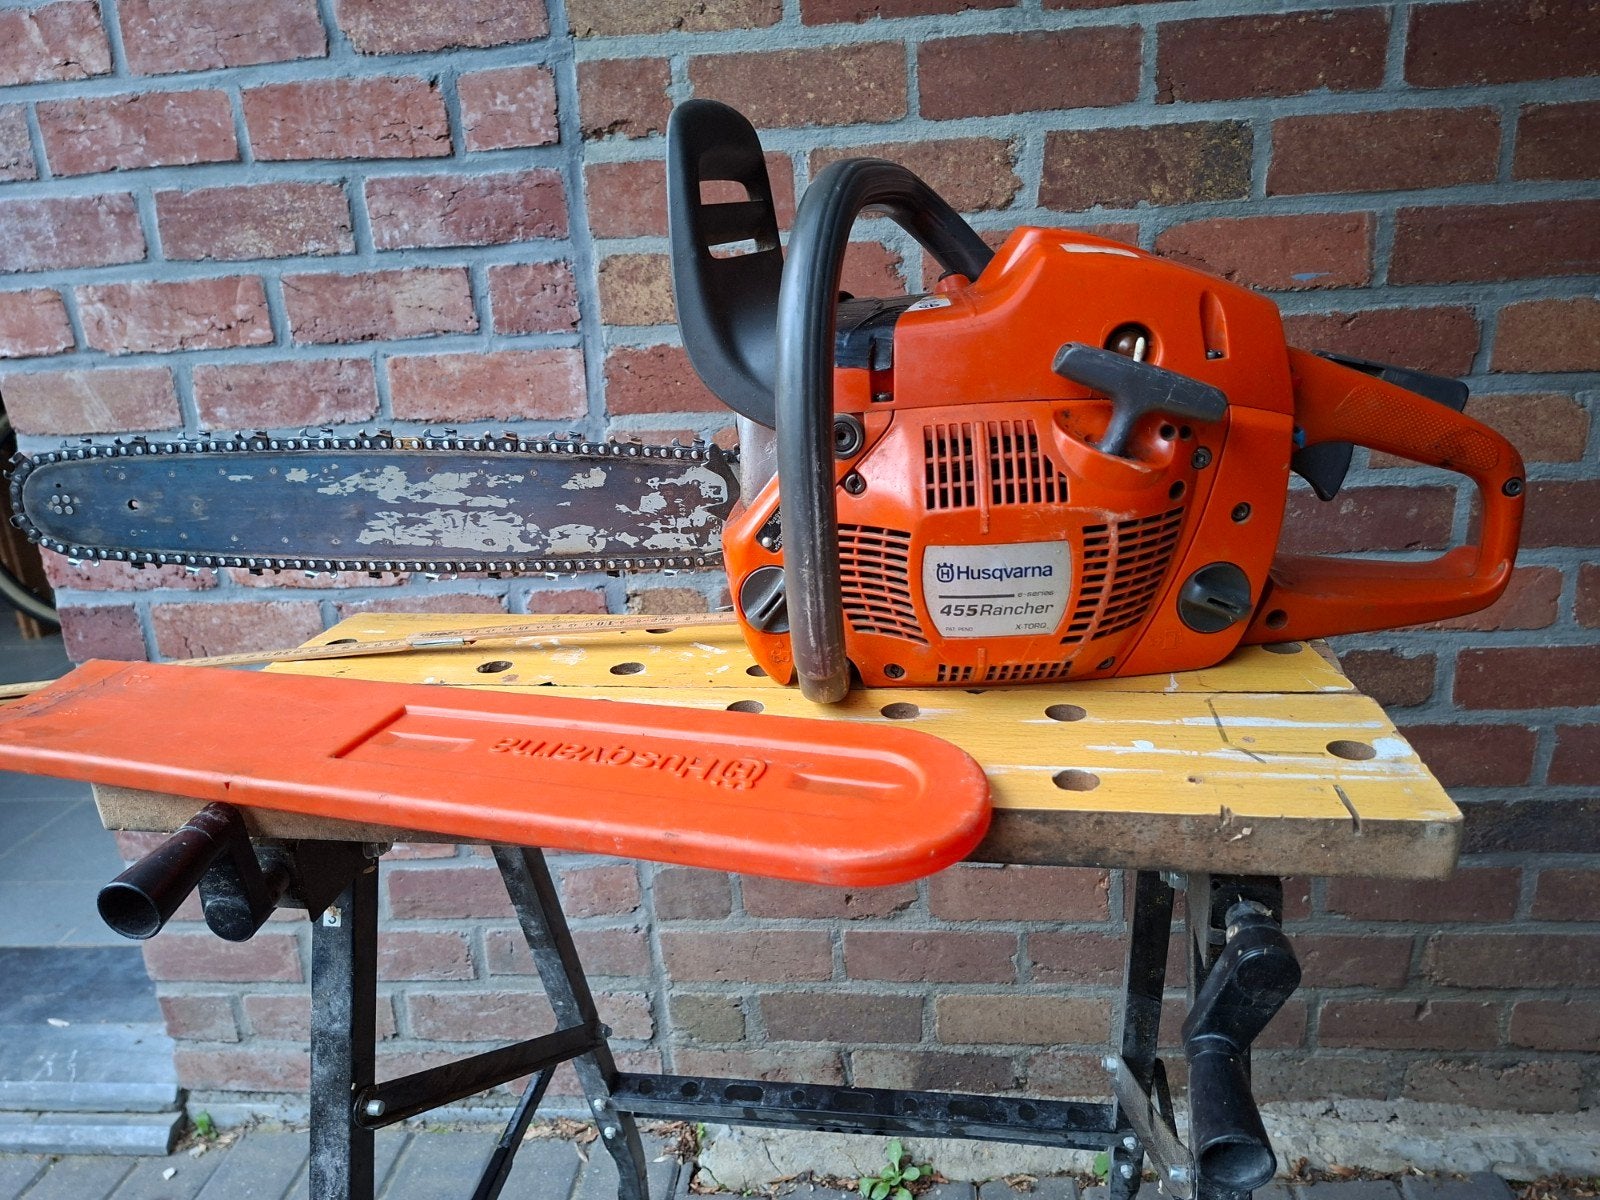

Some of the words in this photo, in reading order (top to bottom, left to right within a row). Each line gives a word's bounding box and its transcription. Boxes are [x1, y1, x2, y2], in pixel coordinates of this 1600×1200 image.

[956, 564, 1053, 581] Husqvarna
[1017, 590, 1054, 598] e-series
[939, 604, 979, 617] 455
[979, 602, 1054, 617] Rancher
[489, 738, 721, 780] Husqvarna
